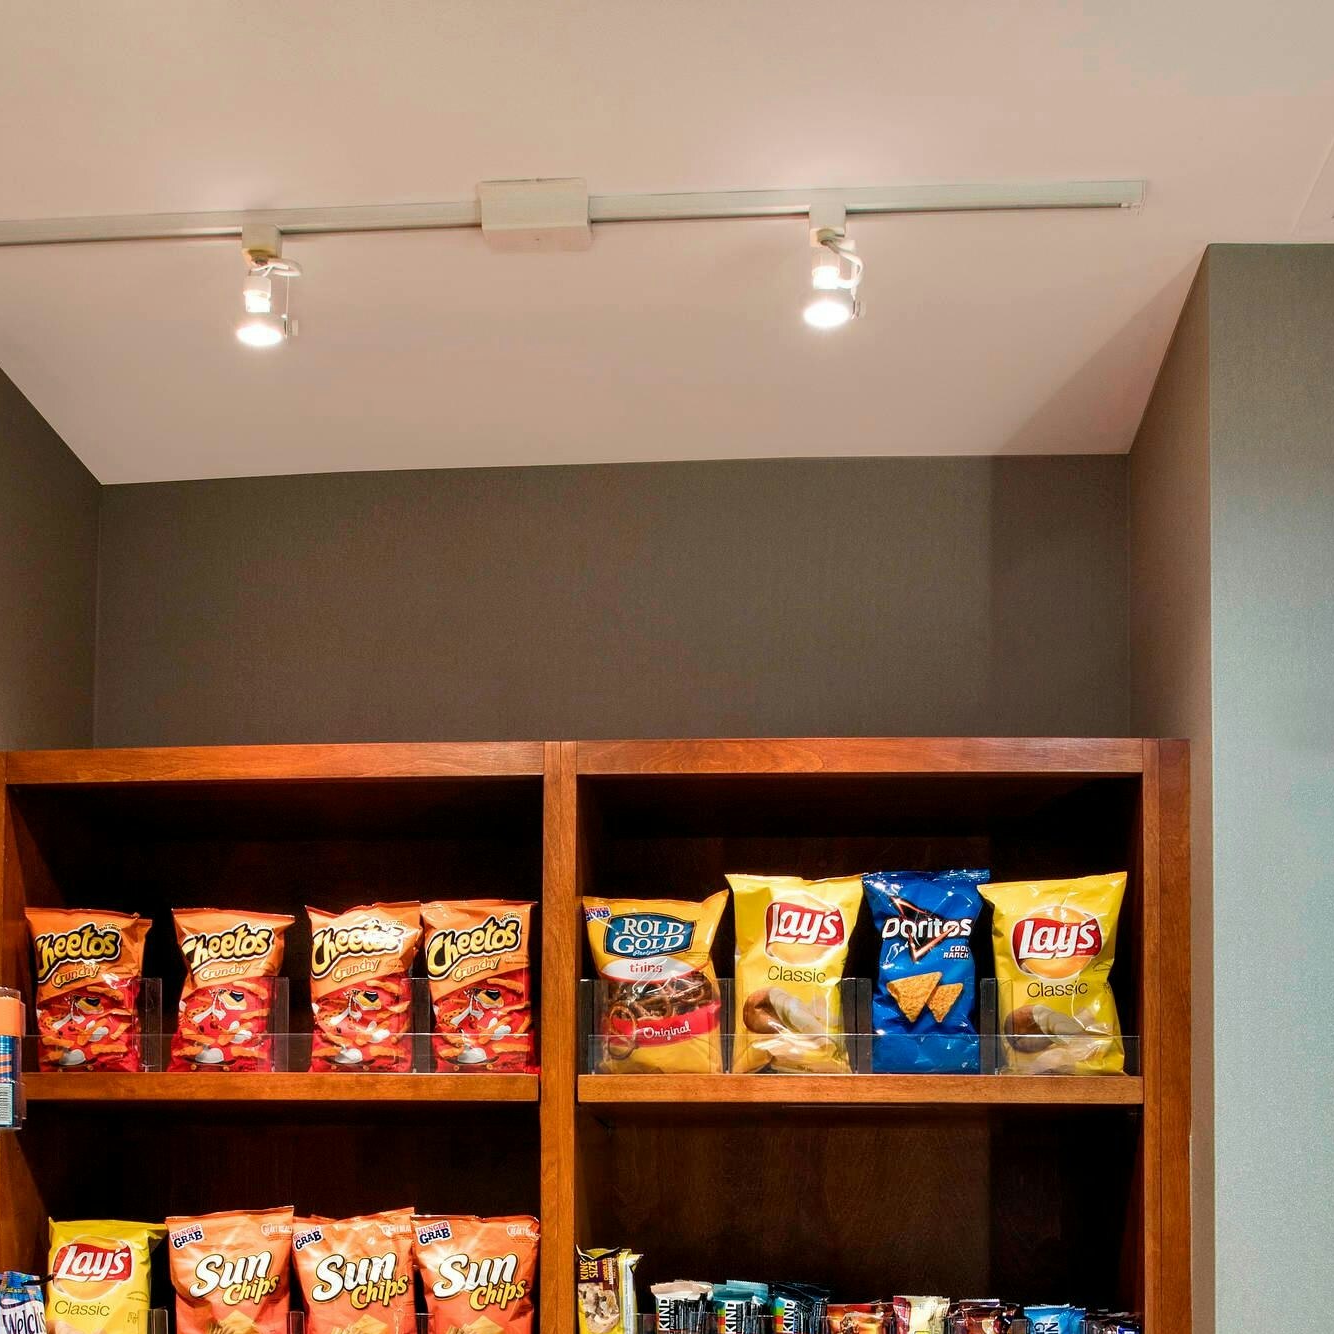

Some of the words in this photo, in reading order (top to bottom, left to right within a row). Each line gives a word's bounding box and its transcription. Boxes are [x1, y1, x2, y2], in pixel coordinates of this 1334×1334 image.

[622, 917, 686, 937] ROLD
[768, 903, 844, 945] Lay's
[882, 918, 971, 938] Doritos
[427, 917, 521, 977] Cheetos
[613, 935, 685, 953] GOLD
[1019, 920, 1097, 960] Lay's
[51, 964, 99, 988] Crunchy
[199, 963, 250, 981] Crunchy
[452, 956, 500, 981] Crunchy
[630, 963, 662, 974] thins
[768, 965, 826, 984] Classic
[1027, 980, 1088, 998] Classic
[643, 1023, 691, 1041] Original
[171, 1225, 202, 1240] HUNGER
[173, 1231, 203, 1249] GRAB
[418, 1222, 449, 1236] HUNGER
[419, 1228, 450, 1245] GRAB
[55, 1246, 130, 1282] Lay's
[190, 1251, 272, 1298] Sun
[312, 1252, 397, 1302] Sun
[223, 1275, 279, 1305] Chips
[351, 1275, 408, 1309] Chips
[55, 1300, 110, 1317] Classic
[659, 1297, 670, 1331] KIND
[726, 1301, 737, 1334] KIND
[783, 1300, 794, 1333] KIND
